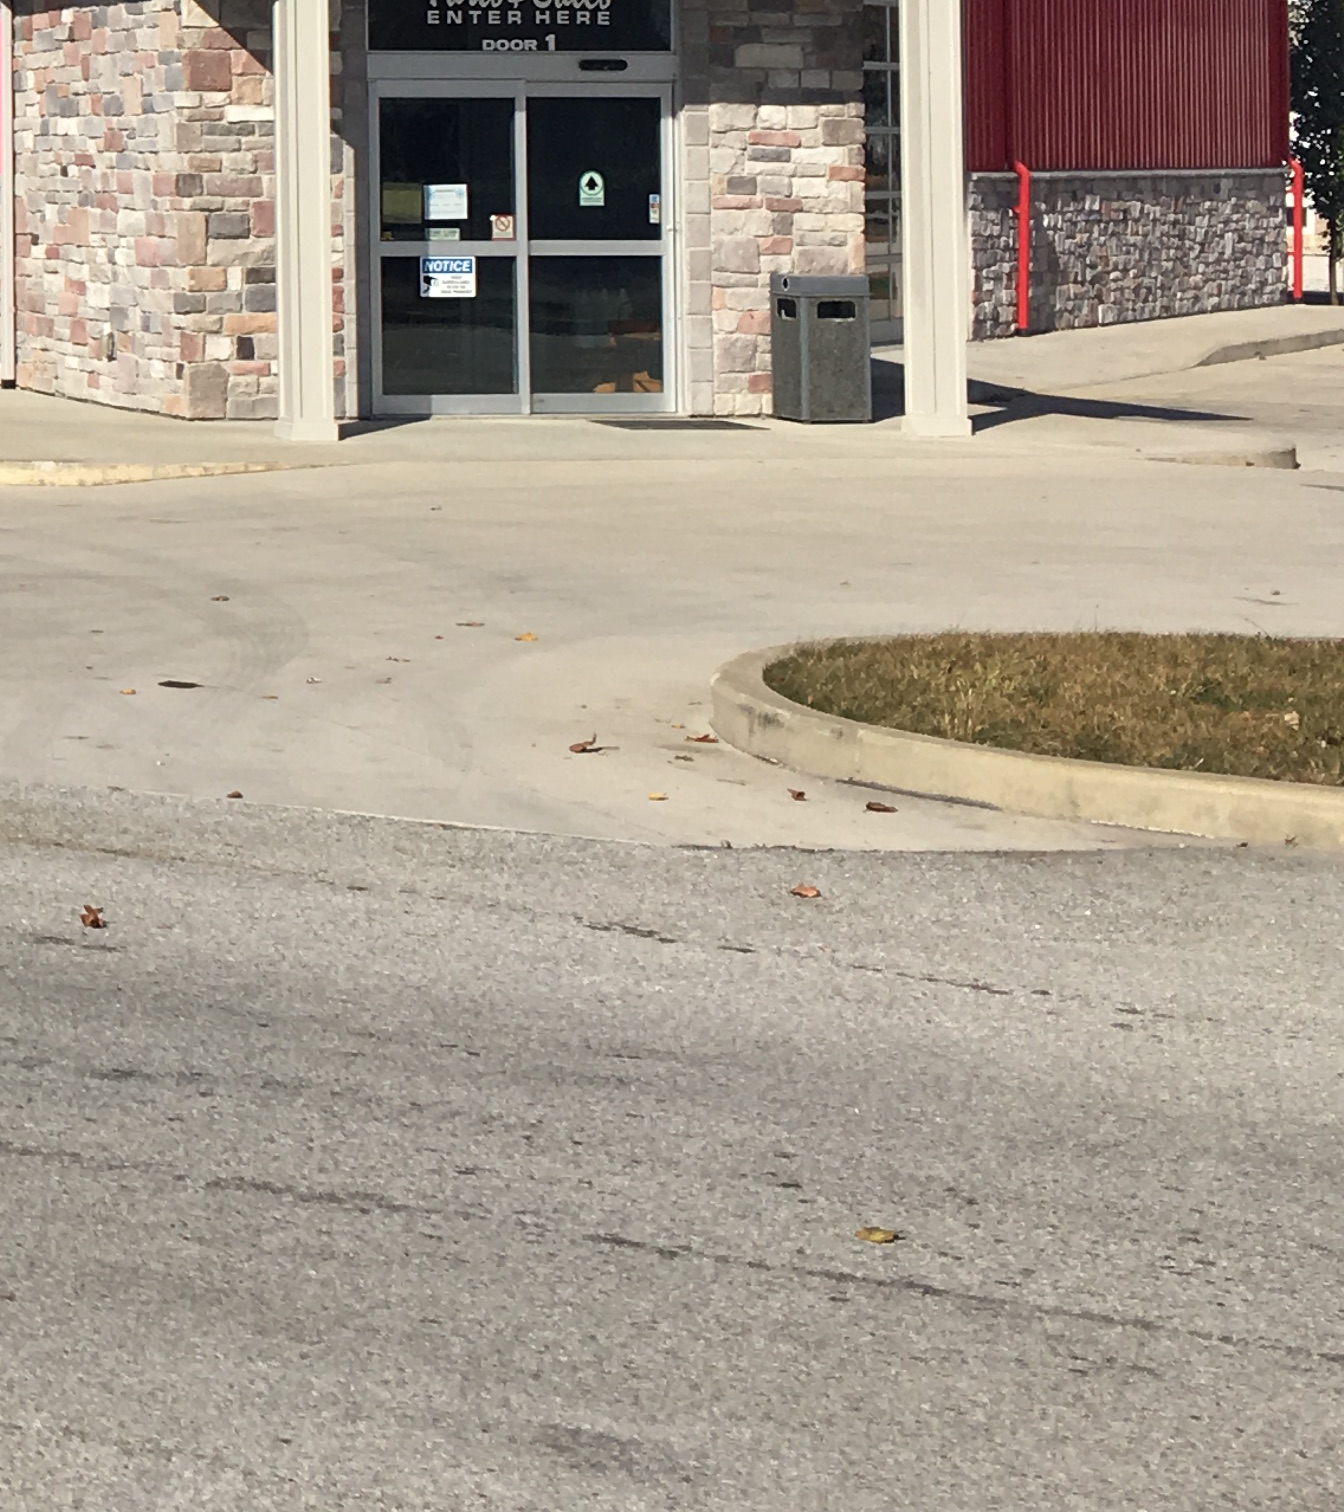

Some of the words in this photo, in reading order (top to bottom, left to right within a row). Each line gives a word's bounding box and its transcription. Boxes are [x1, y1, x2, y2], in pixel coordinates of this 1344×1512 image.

[427, 10, 522, 25] ENTER
[535, 10, 610, 26] HERE
[482, 39, 538, 51] DOOR
[545, 34, 556, 51] 1
[424, 260, 470, 272] NOTICE
